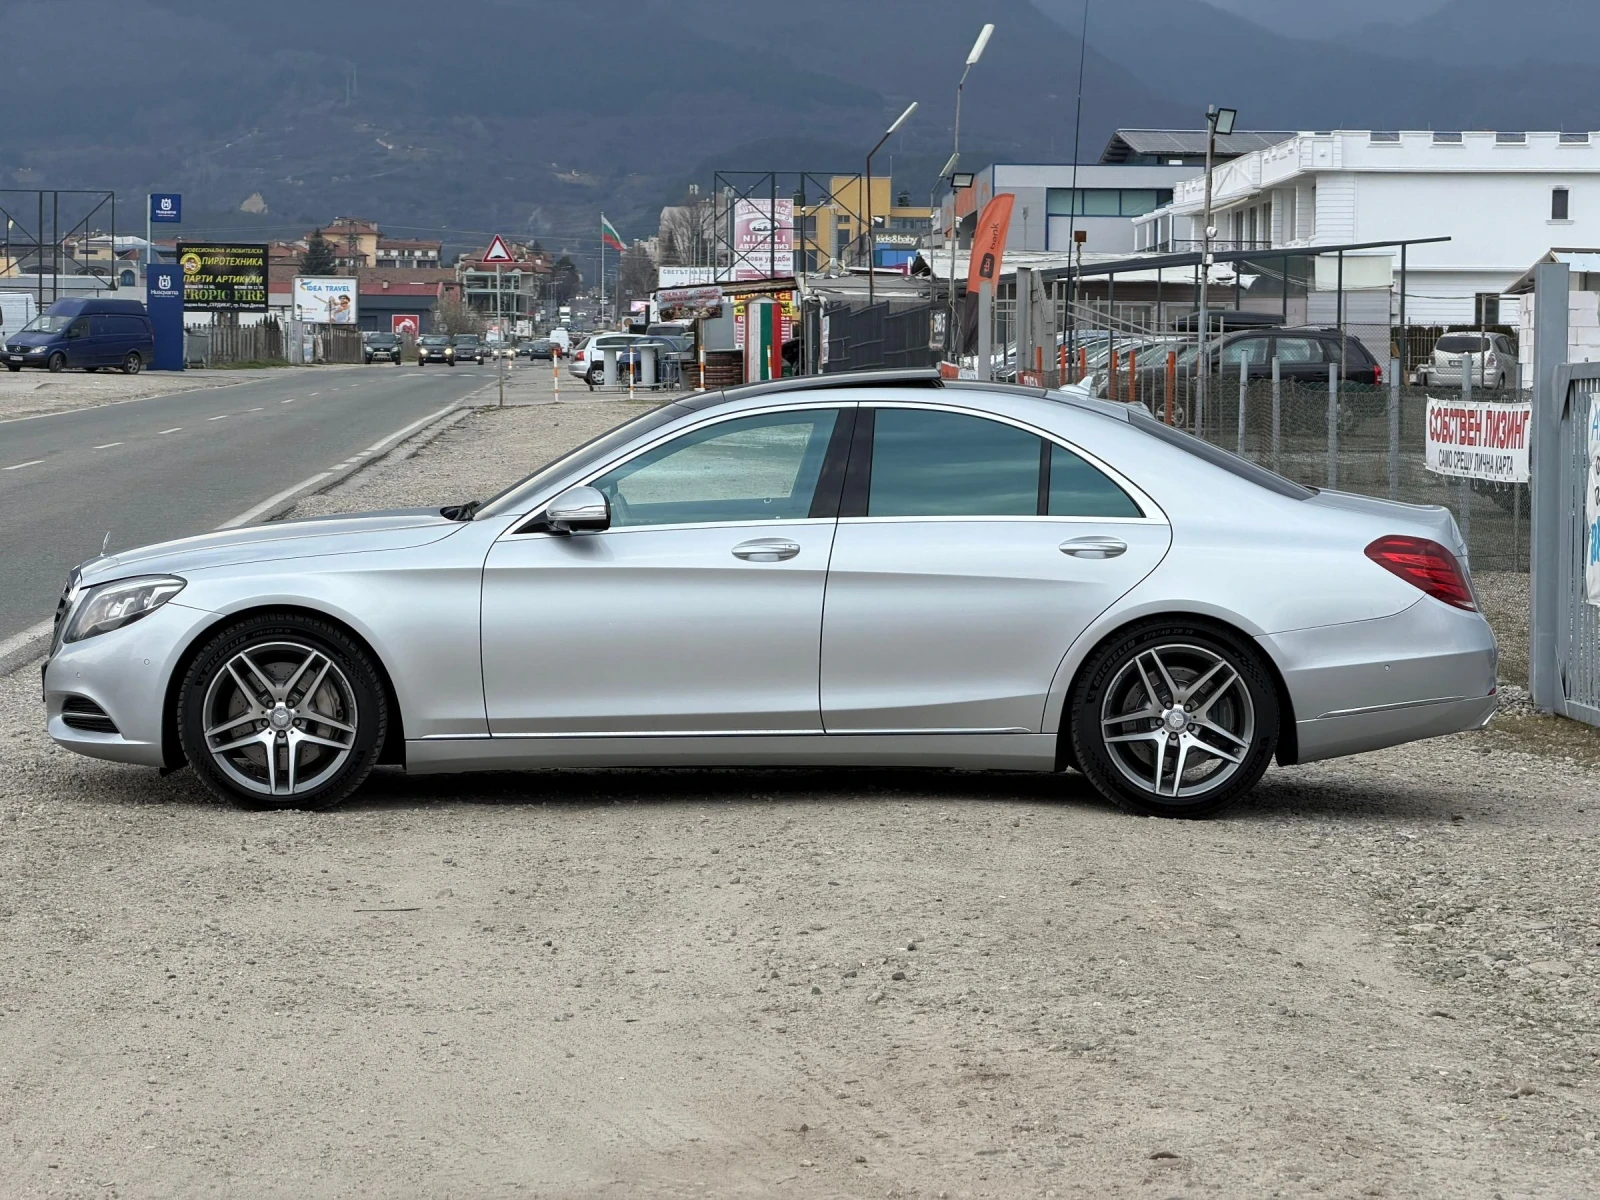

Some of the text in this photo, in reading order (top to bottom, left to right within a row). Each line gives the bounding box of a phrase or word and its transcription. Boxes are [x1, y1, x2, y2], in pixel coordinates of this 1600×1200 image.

[738, 204, 791, 215] AUTOSERICE
[876, 234, 918, 246] kids&baby
[990, 223, 999, 250] bank
[201, 256, 263, 266] ПИРОТЕХНИКА
[216, 275, 263, 283] АРТИКУЛИ
[183, 289, 265, 301] TROPIC FIRE
[1429, 406, 1530, 449] СОБСТВЕН ЛИЗИНГ
[1438, 449, 1514, 475] САМО СРЕЩУ ЛИЧНА КАРТА
[1093, 639, 1136, 687] MICHELIN
[1143, 629, 1171, 640] 275/40
